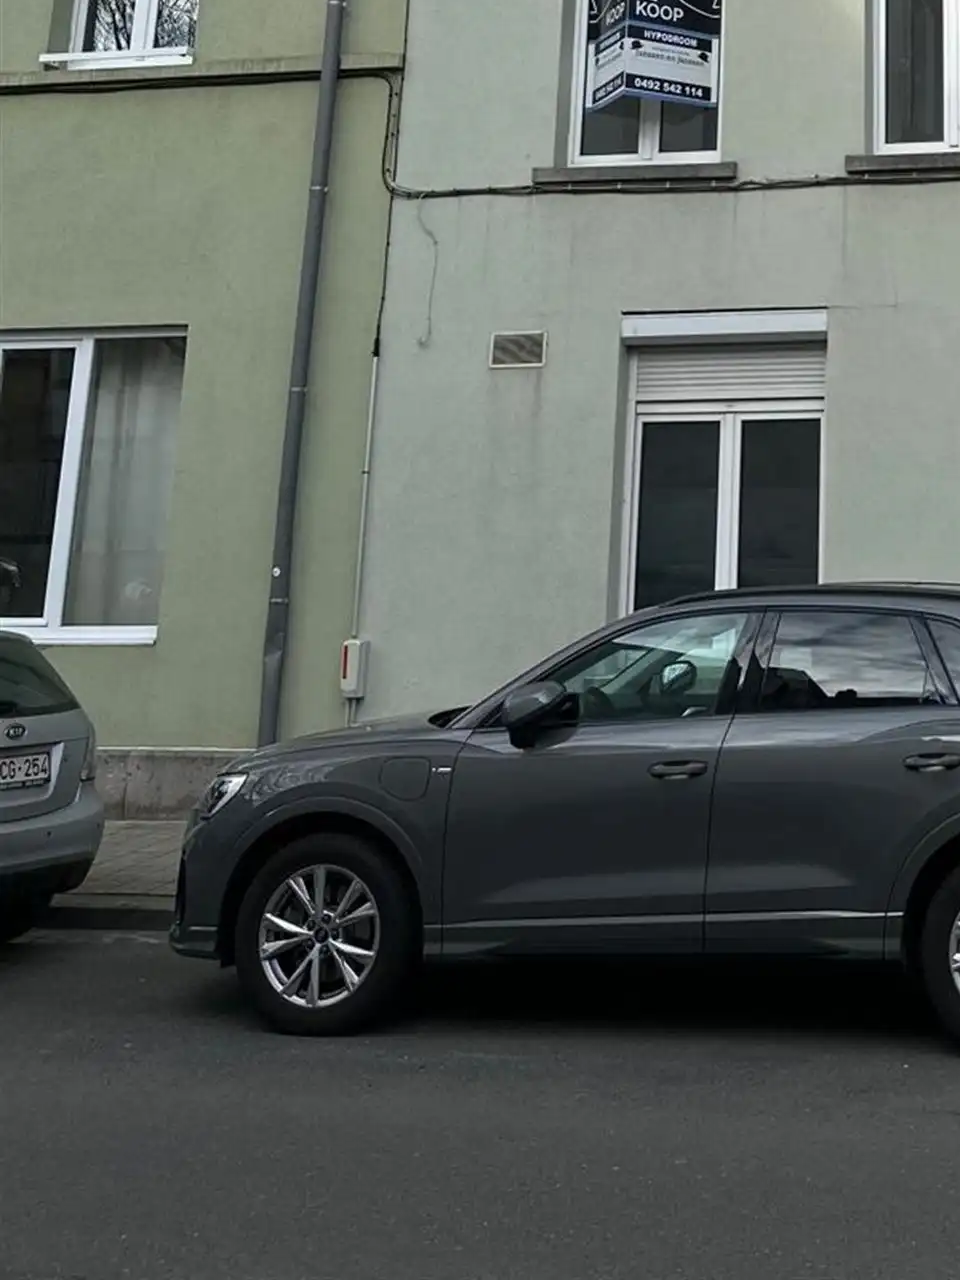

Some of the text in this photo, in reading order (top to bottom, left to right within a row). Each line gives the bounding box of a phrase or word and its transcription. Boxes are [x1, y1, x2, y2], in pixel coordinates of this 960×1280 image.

[636, 0, 684, 22] KOOP
[634, 77, 661, 90] 0492
[685, 86, 703, 97] 114
